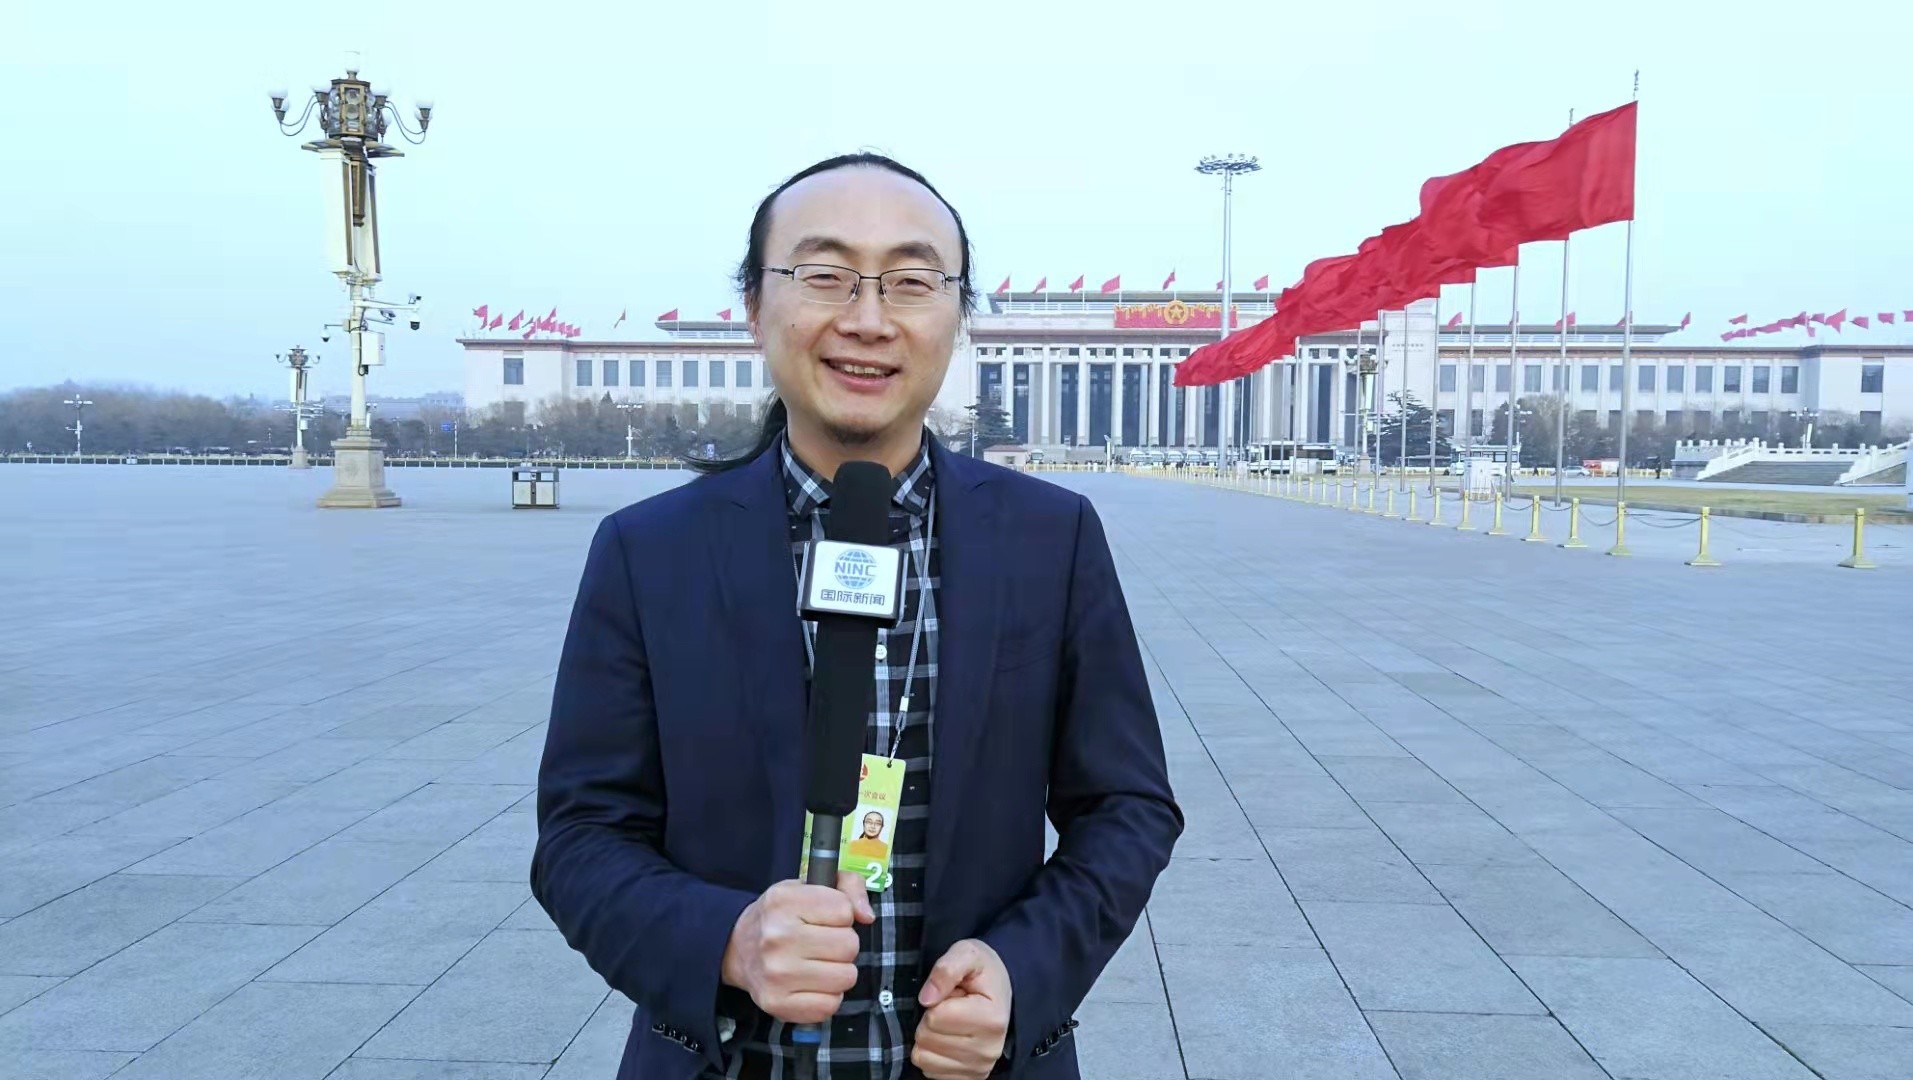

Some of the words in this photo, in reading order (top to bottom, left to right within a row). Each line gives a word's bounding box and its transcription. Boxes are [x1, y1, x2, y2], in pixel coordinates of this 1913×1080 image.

[834, 562, 877, 576] NINC
[820, 589, 885, 606] 国际新闻
